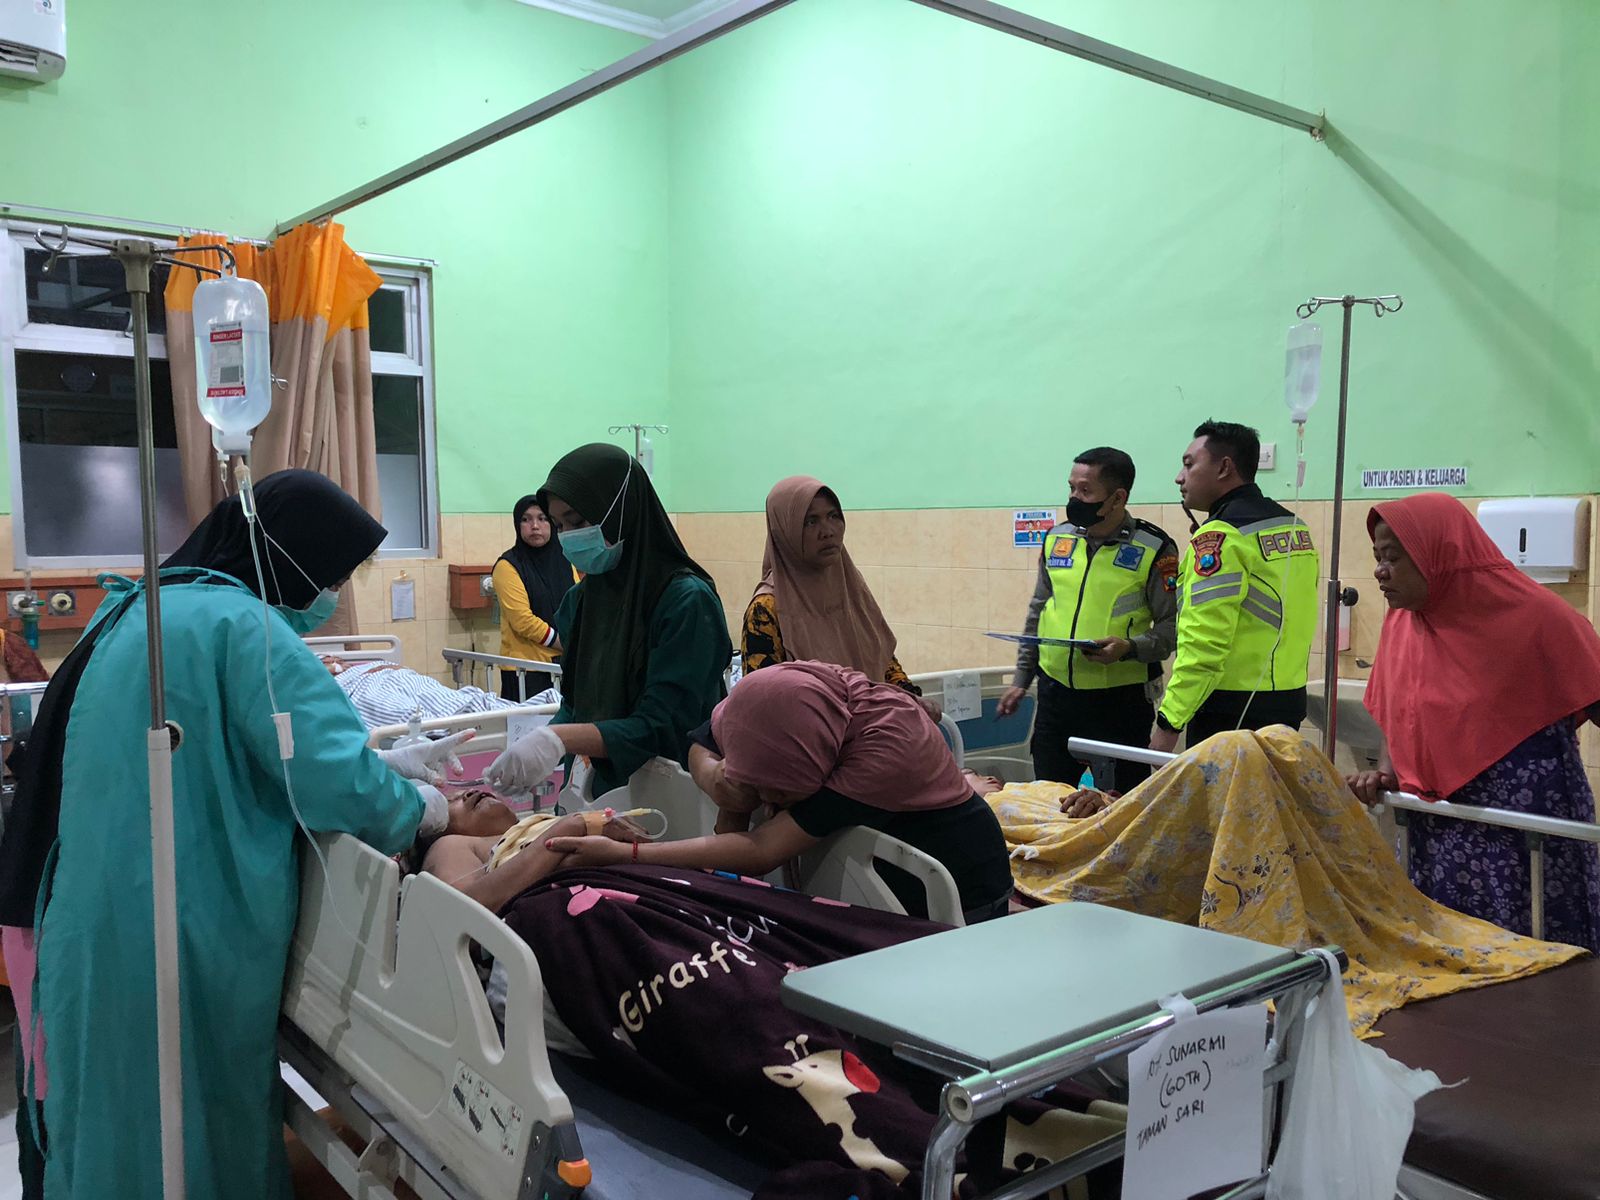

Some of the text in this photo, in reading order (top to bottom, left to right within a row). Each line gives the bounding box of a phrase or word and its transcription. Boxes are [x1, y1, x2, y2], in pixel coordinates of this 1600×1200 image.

[1363, 468, 1466, 487] UNTUK PASIEN & KELUARGA
[618, 940, 757, 1033] Giraffe
[1165, 1035, 1226, 1067] SUNARMI
[1136, 1099, 1205, 1151] TAMAN SARI
